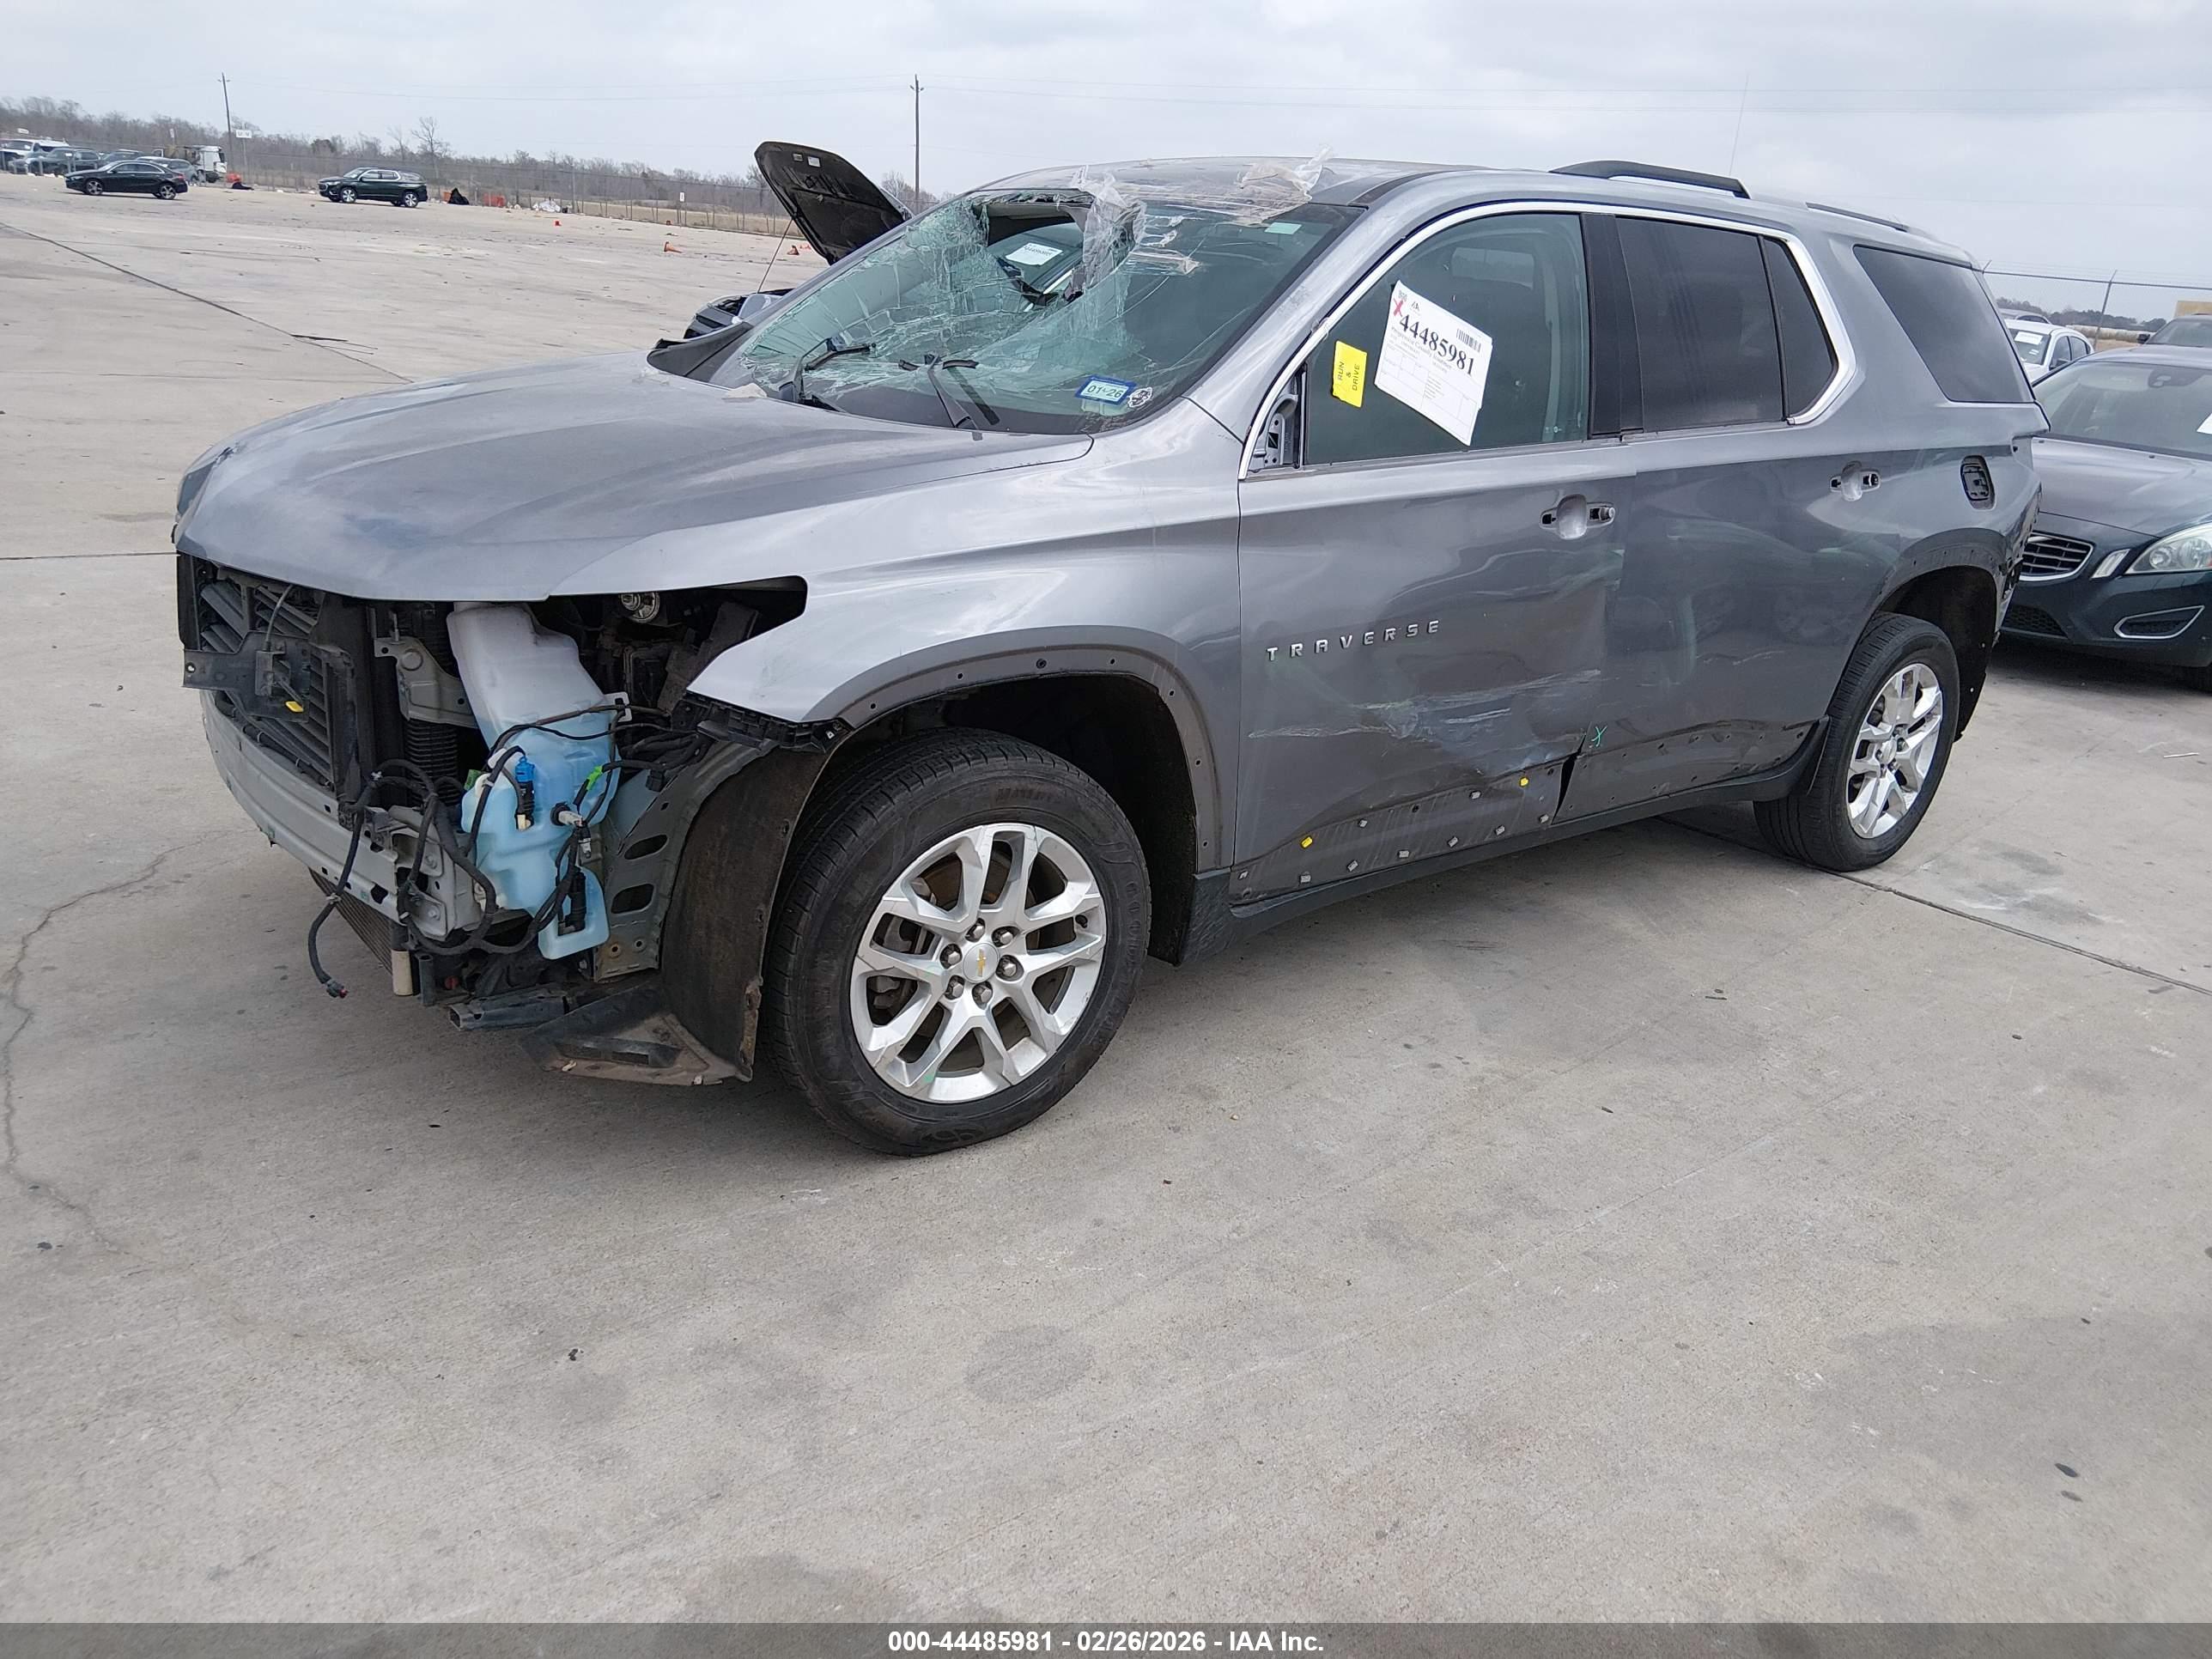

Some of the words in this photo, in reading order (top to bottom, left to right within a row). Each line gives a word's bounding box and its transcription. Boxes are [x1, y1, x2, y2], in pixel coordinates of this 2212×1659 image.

[1399, 314, 1474, 375] 44485981
[1352, 364, 1360, 392] DRIVE
[1267, 620, 1440, 661] TRAVERSE
